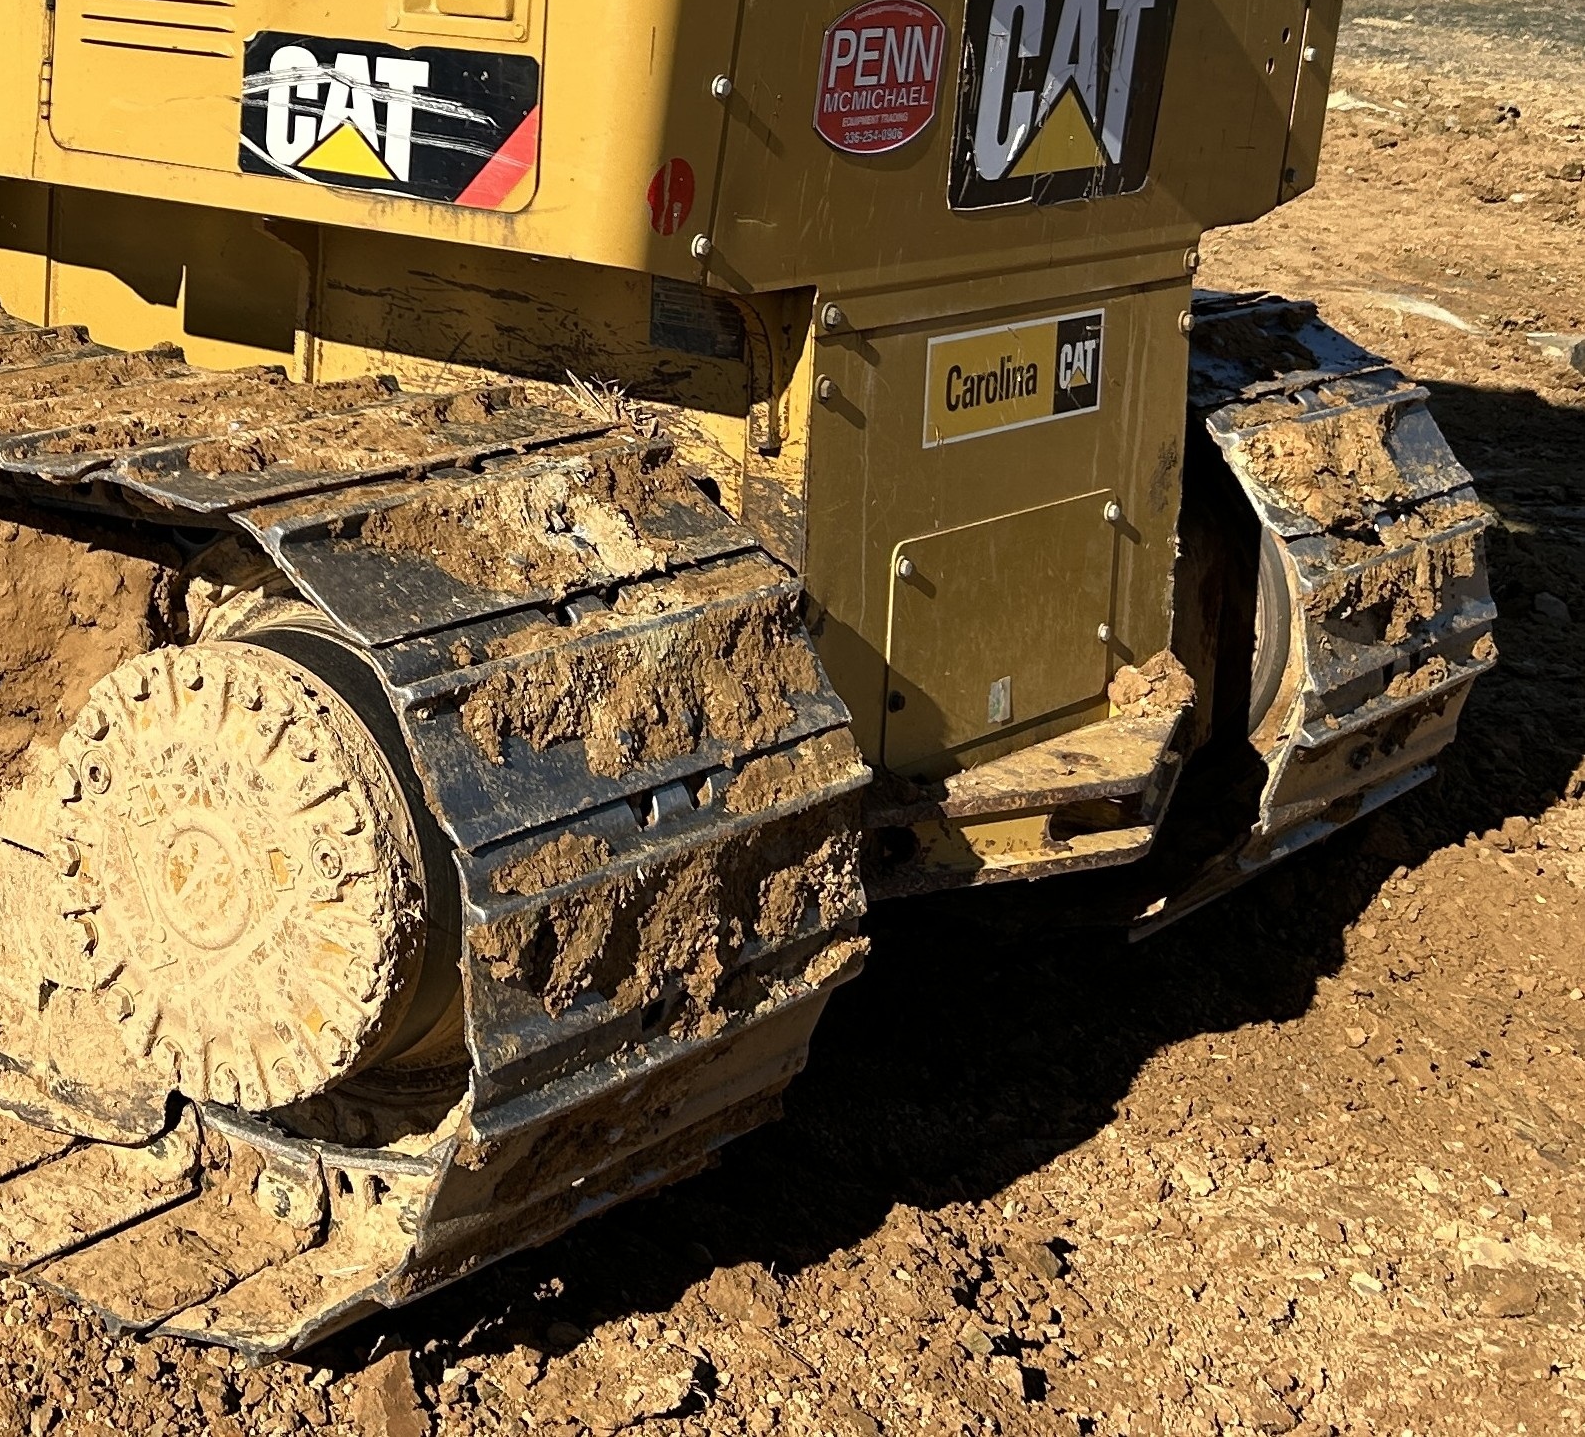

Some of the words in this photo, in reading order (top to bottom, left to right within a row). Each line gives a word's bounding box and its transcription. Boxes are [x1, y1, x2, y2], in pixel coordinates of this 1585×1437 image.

[827, 24, 939, 89] PENN
[265, 45, 430, 183] CAT
[823, 85, 930, 114] MCMICHAEL
[841, 113, 880, 128] EQUIPMENT
[880, 111, 909, 125] TRADING
[945, 353, 1039, 413] Carolina
[1059, 339, 1097, 391] CAT
